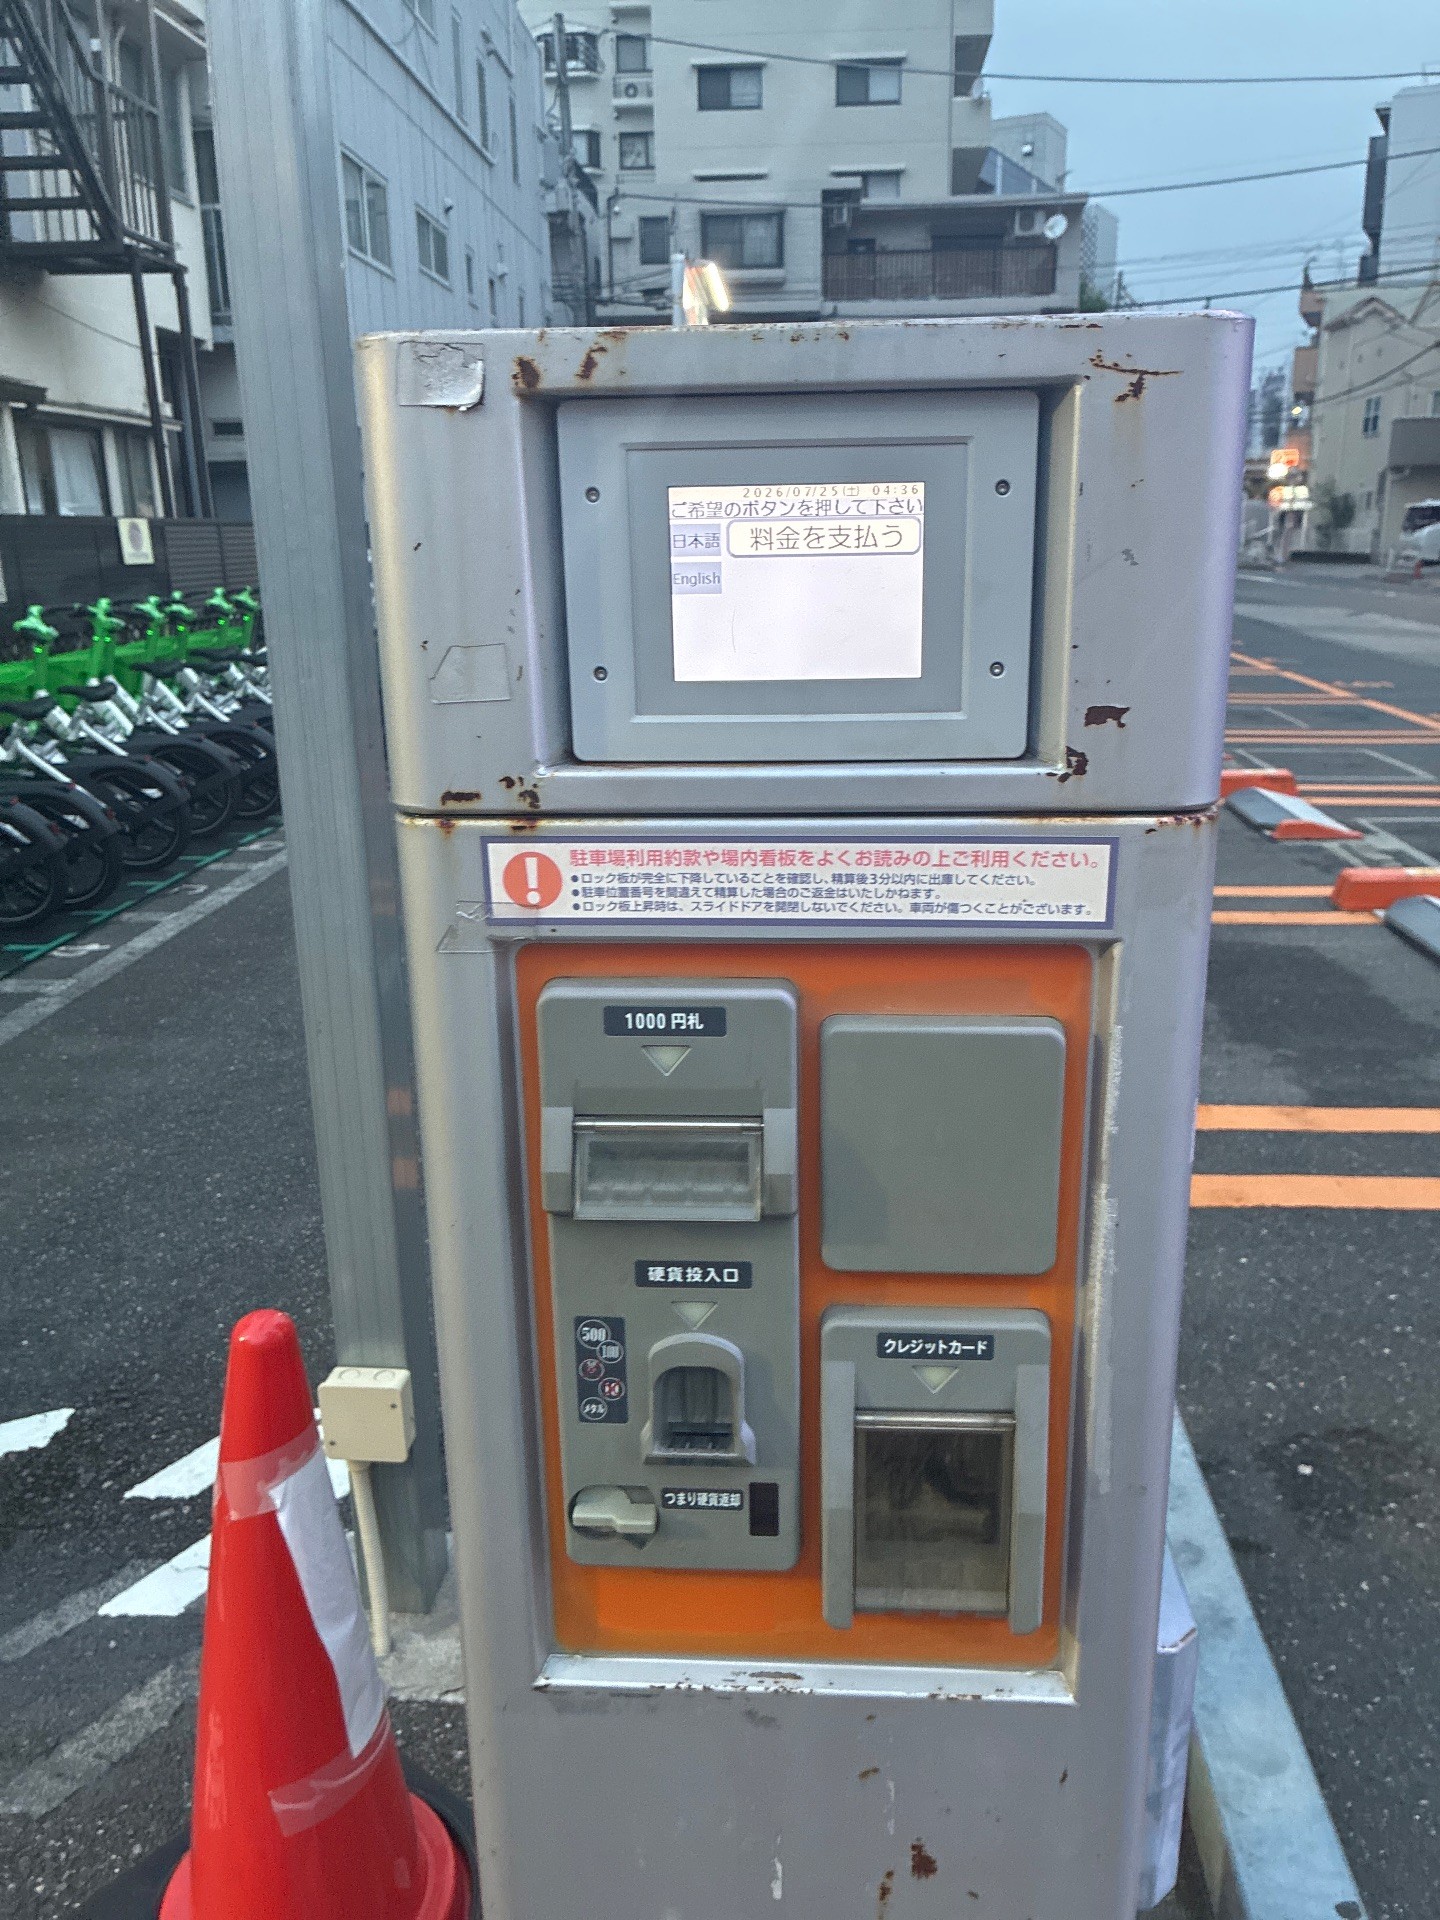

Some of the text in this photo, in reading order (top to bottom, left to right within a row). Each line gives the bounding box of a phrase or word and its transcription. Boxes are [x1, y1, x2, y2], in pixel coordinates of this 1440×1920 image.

[872, 484, 918, 496] 04:36
[672, 498, 923, 519] ご希望のボタンを押して下さい
[673, 533, 720, 549] 日本語
[750, 525, 903, 551] 料金を支払う
[673, 572, 721, 587] English
[570, 849, 1099, 868] 駐車場利用約款や場内看板をよくお読みの上ご利用ください。
[647, 1266, 739, 1283] 硬貨投入口
[581, 1327, 606, 1342] 500
[884, 1338, 988, 1356] クレジットカード
